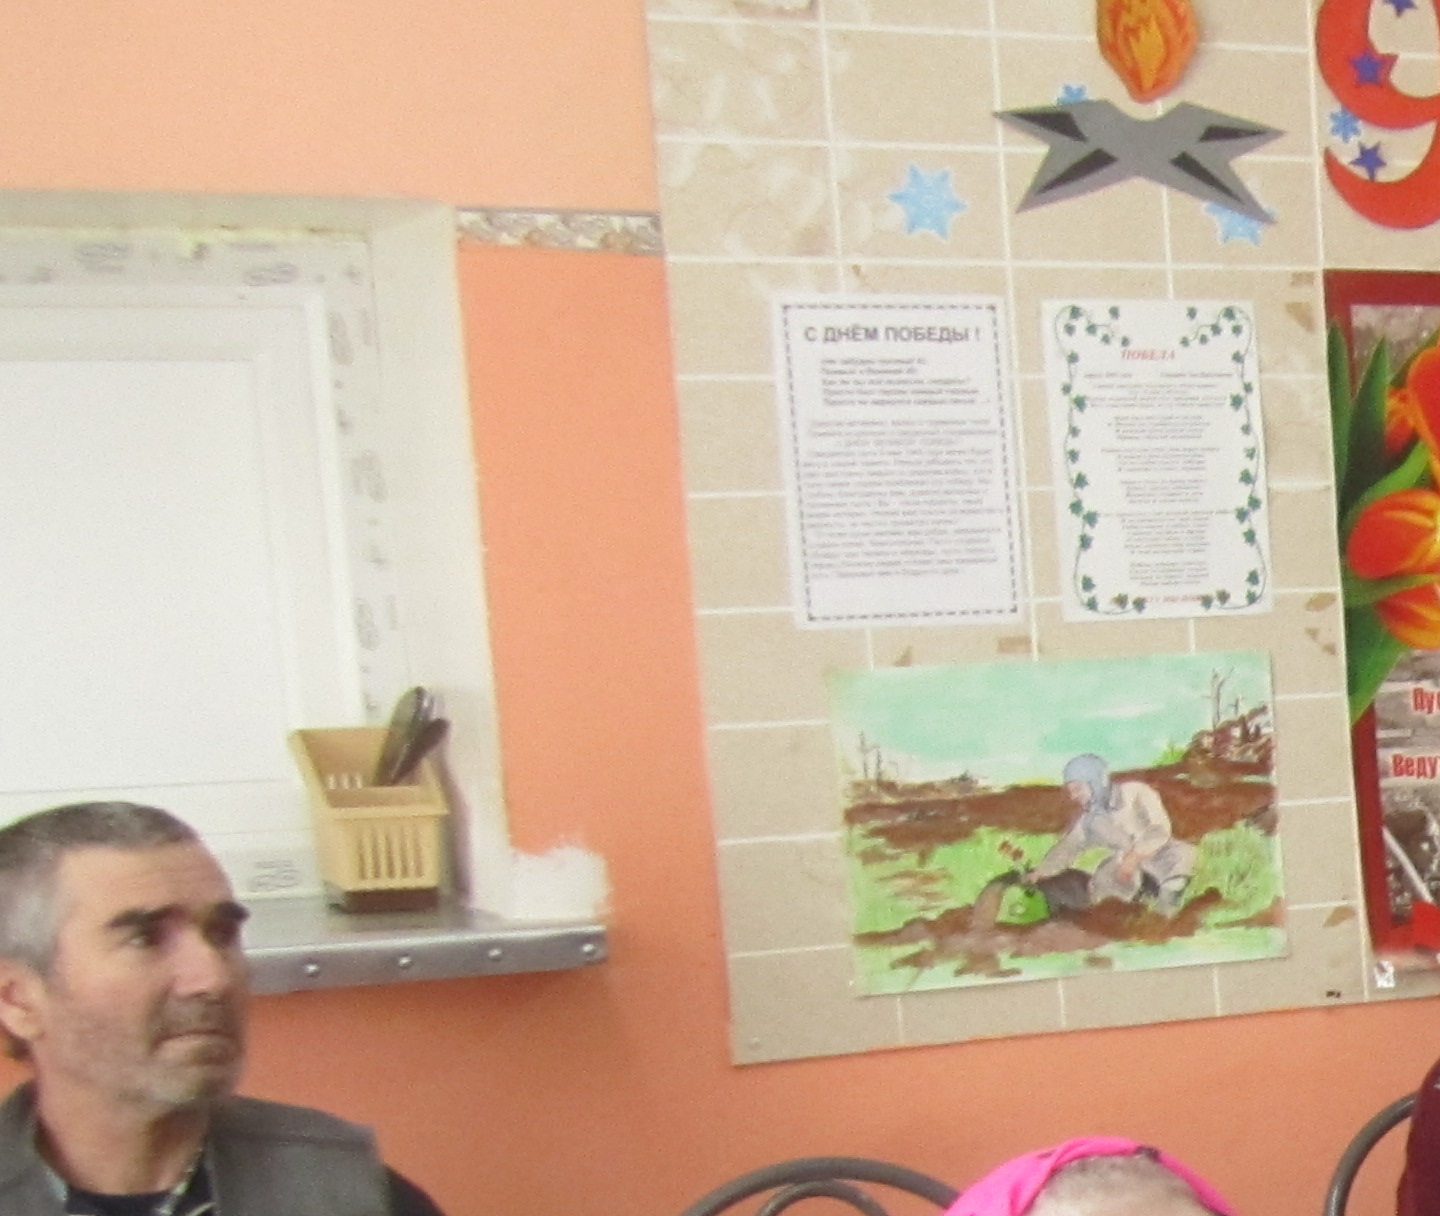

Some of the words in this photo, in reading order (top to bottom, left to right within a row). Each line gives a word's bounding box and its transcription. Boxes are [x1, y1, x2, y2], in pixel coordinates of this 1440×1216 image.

[803, 326, 817, 342] С
[823, 323, 878, 345] ДНЁМ
[885, 325, 969, 345] ПОБЕДЫ
